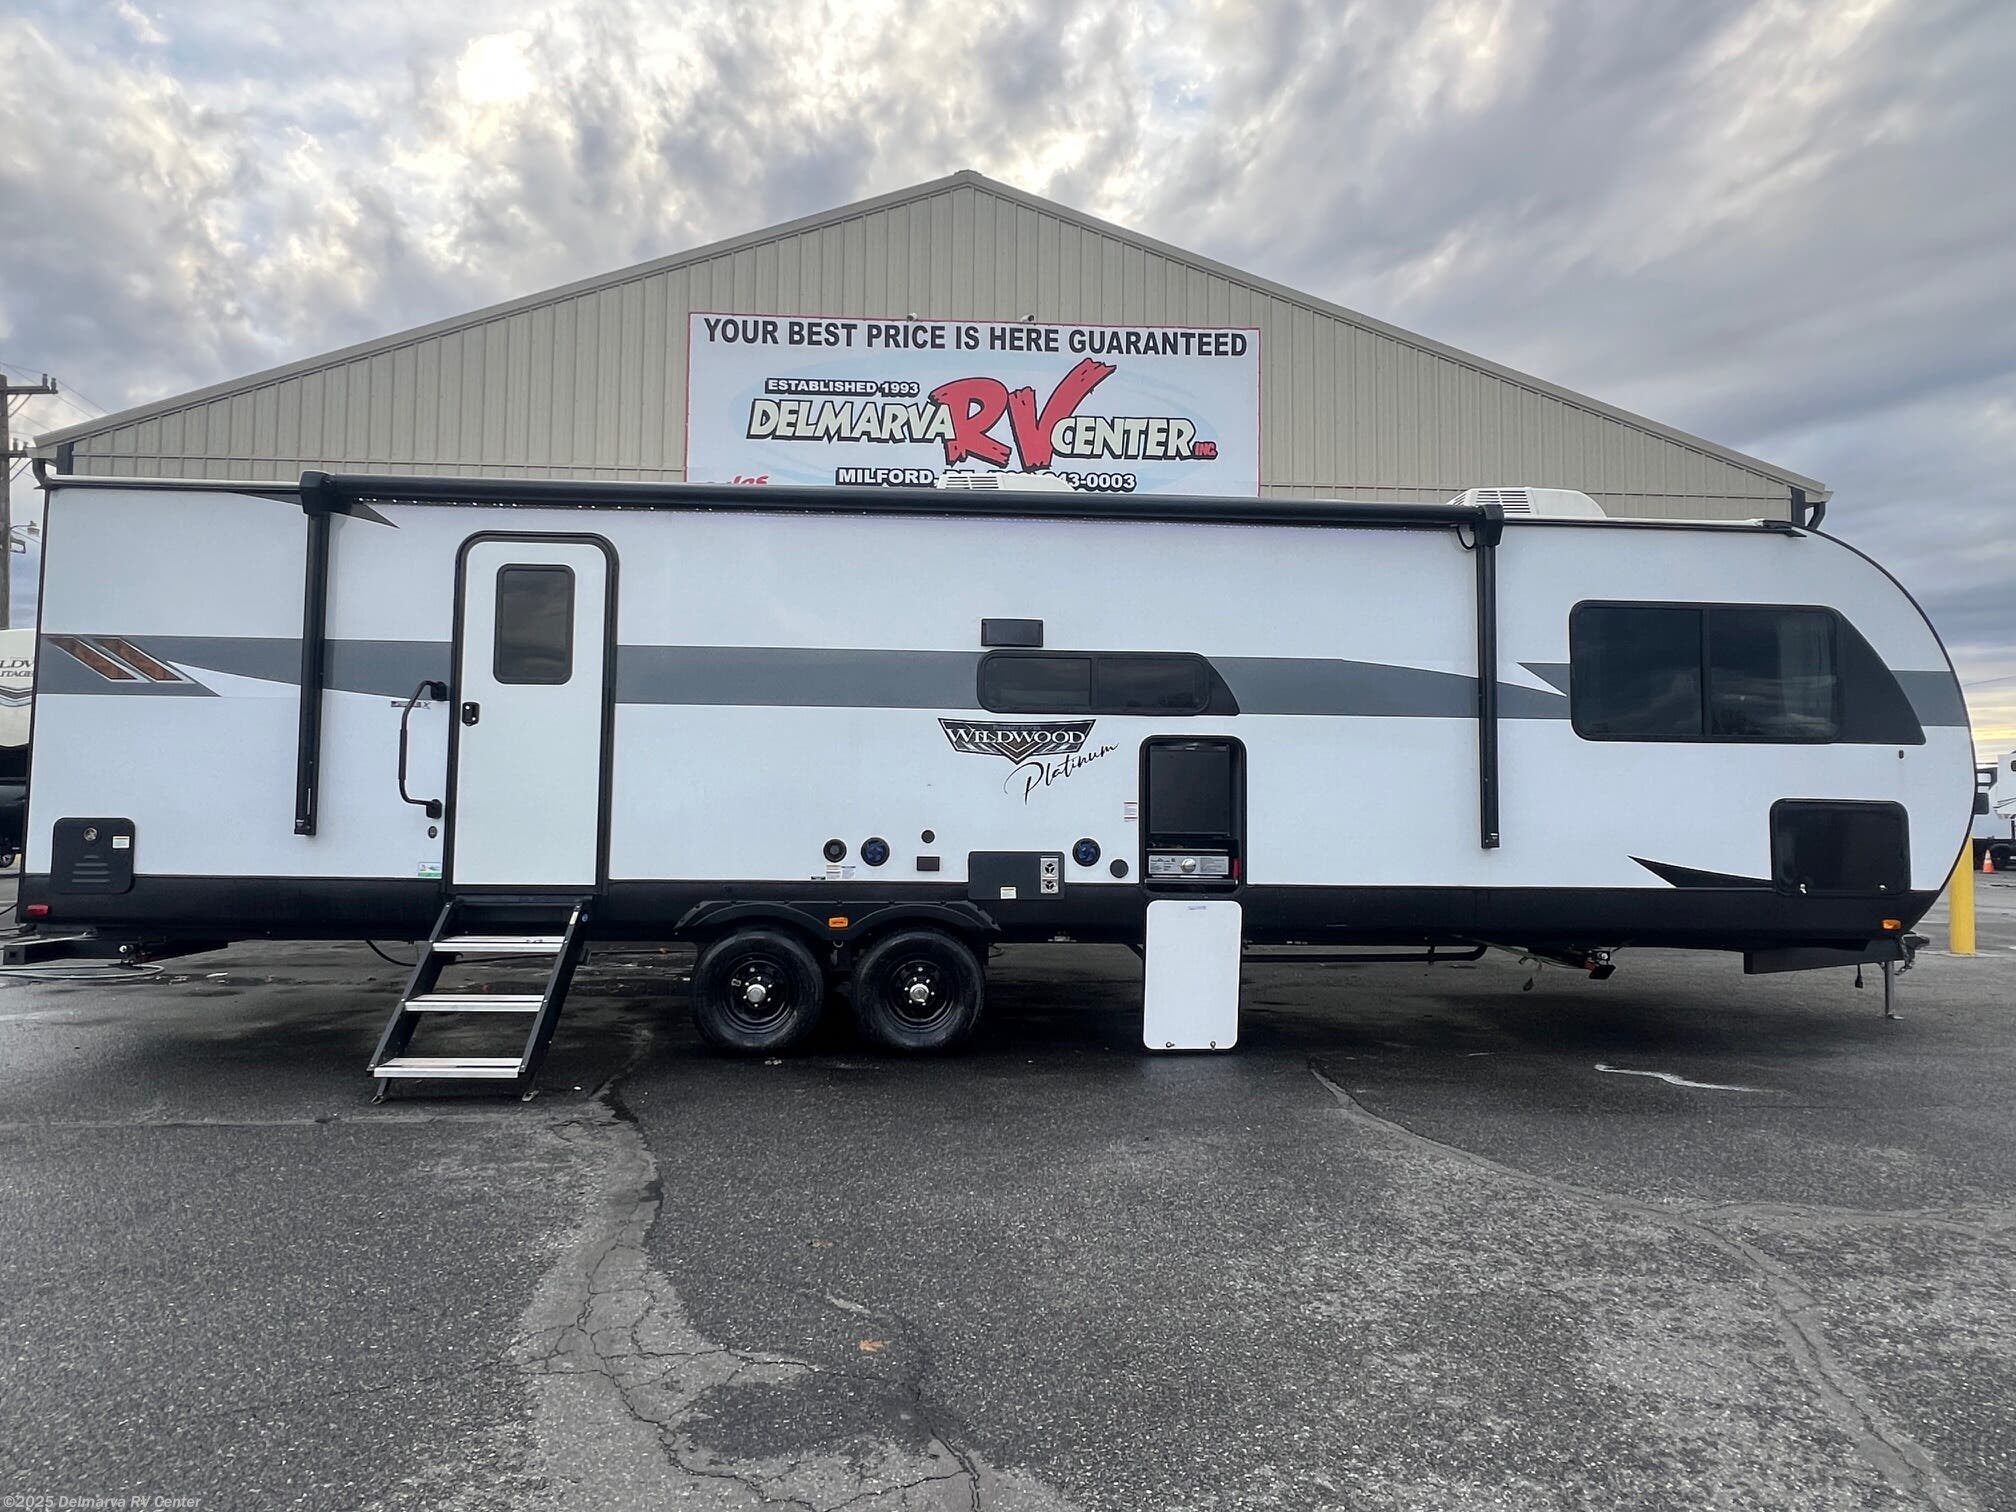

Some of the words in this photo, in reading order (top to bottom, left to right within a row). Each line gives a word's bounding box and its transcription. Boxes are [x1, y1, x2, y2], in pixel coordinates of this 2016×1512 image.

[704, 317, 779, 345] YOUR
[788, 321, 858, 347] BEST
[867, 324, 946, 349] PRICE
[956, 326, 980, 350] IS
[989, 327, 1060, 352] HERE
[1069, 330, 1248, 356] GUARANTEED
[766, 378, 879, 394] ESTABLISHED
[881, 382, 920, 396] 1993
[747, 399, 957, 441] DELMARVA
[930, 358, 1117, 469] RV
[1050, 416, 1197, 459] CENTER
[946, 728, 1086, 744] WILDWOOD
[1003, 743, 1119, 805] Platinum
